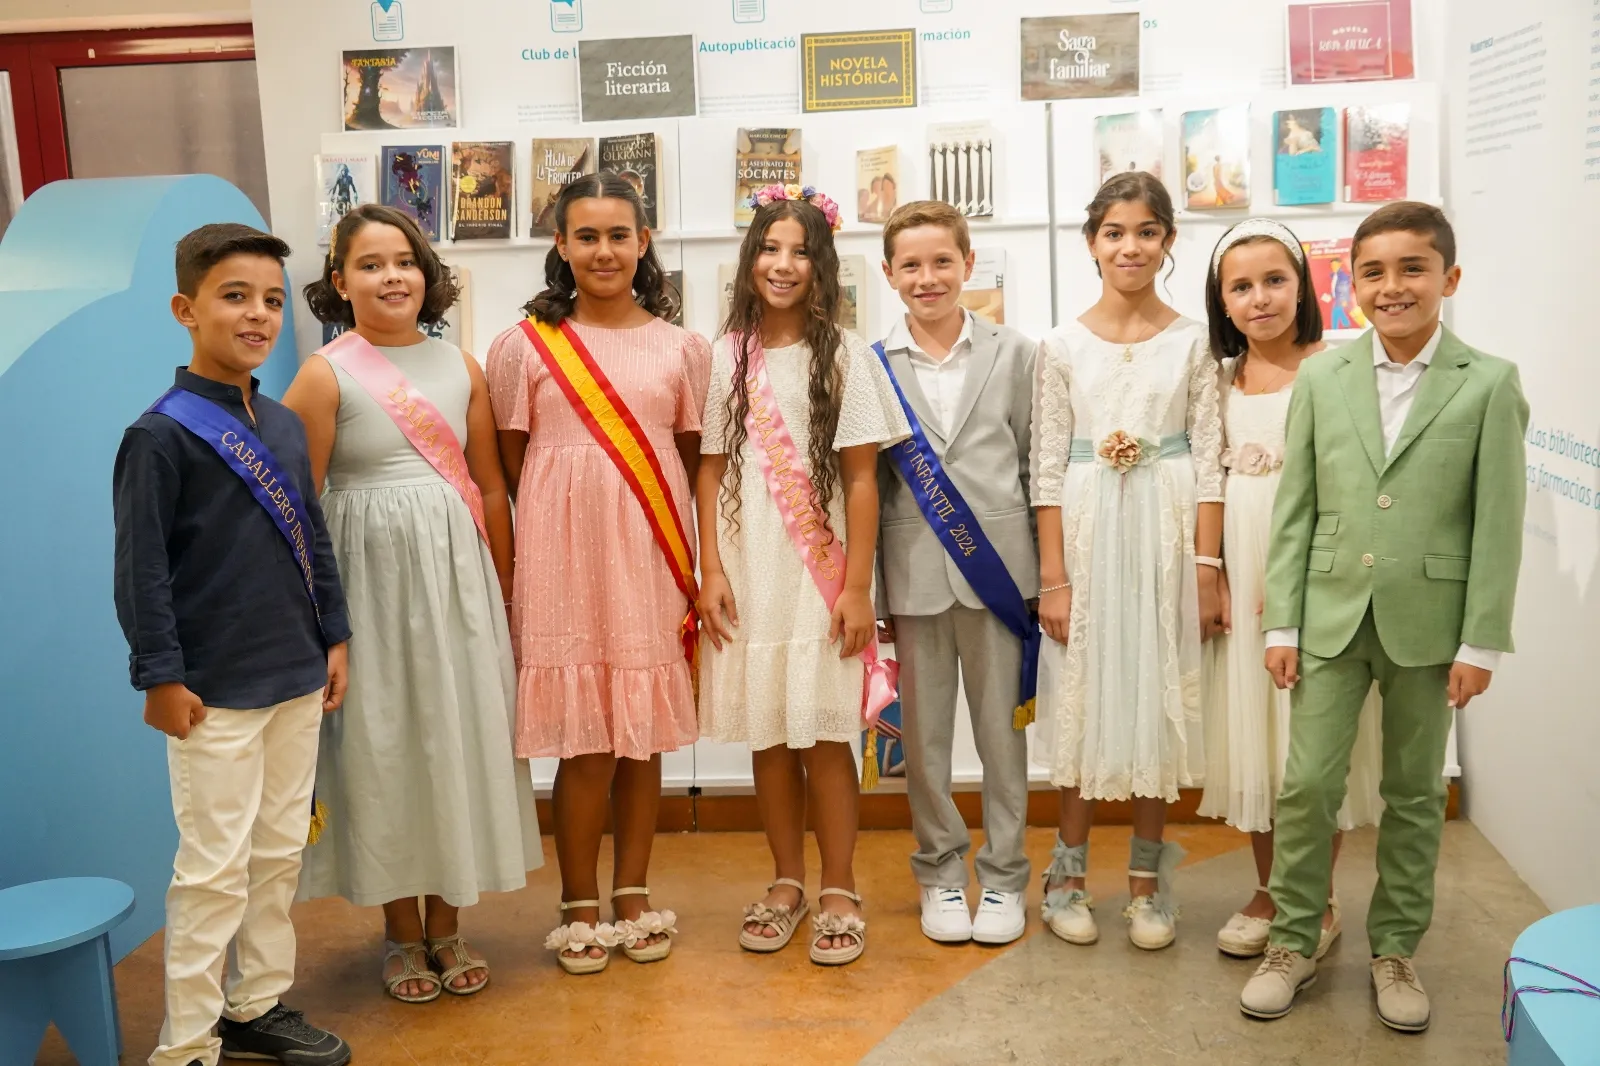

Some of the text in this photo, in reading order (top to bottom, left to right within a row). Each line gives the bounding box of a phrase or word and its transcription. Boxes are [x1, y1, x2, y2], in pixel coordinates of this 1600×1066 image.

[699, 37, 797, 54] Autopublicació
[1057, 28, 1097, 62] Saga
[521, 48, 550, 61] Club
[554, 47, 569, 59] de
[606, 60, 668, 78] Ficción
[830, 56, 888, 72] NOVELA
[1050, 58, 1111, 80] familiar
[820, 69, 899, 87] HISTÓRICA
[605, 78, 671, 96] literaria
[416, 148, 440, 160] YUMI
[603, 149, 652, 162] OLKRANN
[748, 160, 784, 168] ASESINATO
[738, 167, 796, 180] SÓCRATES
[460, 197, 502, 209] BRANDON
[456, 209, 507, 221] SANDERSON
[387, 387, 441, 449] DAMA
[220, 431, 296, 523] CABALLERO
[746, 376, 840, 581] DAMA INFANTIL 2025
[909, 452, 956, 523] INFANTIL
[949, 523, 978, 557] 2024
